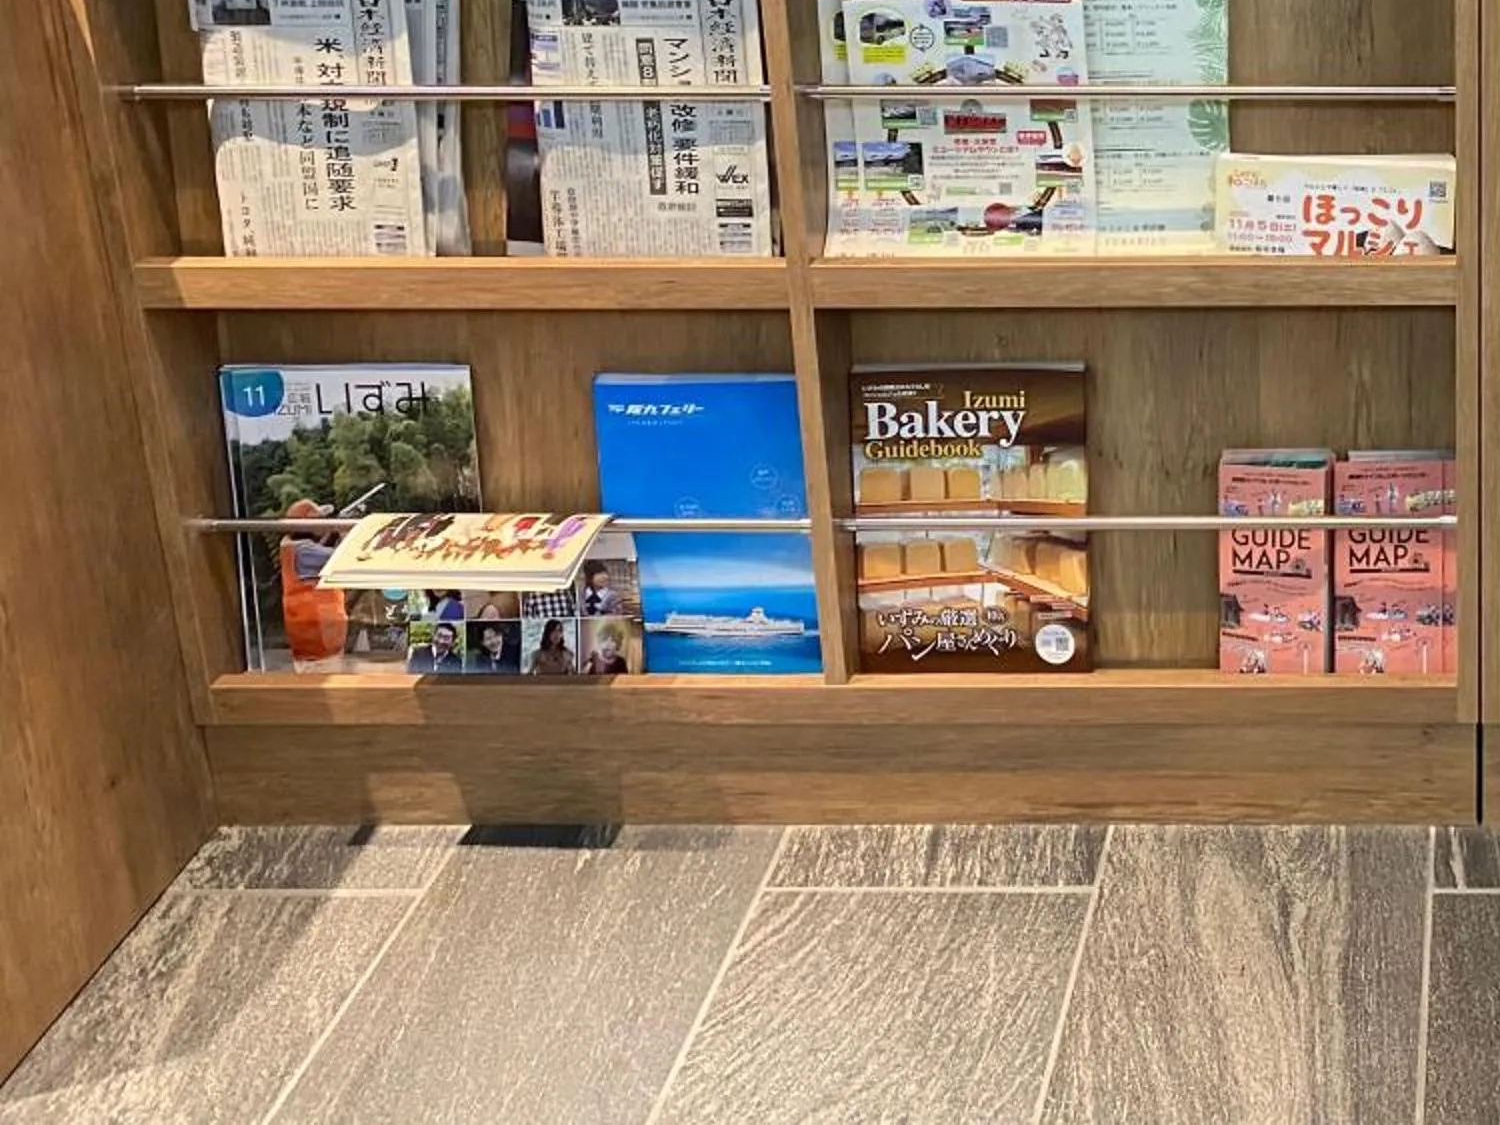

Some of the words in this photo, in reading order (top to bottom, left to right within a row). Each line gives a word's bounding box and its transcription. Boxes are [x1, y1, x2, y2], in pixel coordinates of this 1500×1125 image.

[314, 38, 356, 211] 米、対規制に追随要求
[662, 38, 700, 194] マンシ改修要件緩和
[1302, 194, 1423, 230] ほっこり
[242, 385, 266, 407] 11
[316, 379, 432, 417] いずみ
[963, 390, 1026, 409] Izumi
[864, 400, 1026, 447] Bakery
[865, 439, 984, 460] Guidebook
[1231, 528, 1311, 551] GUIDE
[1348, 528, 1430, 544] GUIDE
[1231, 549, 1291, 570] MAP
[1348, 544, 1409, 567] MAP
